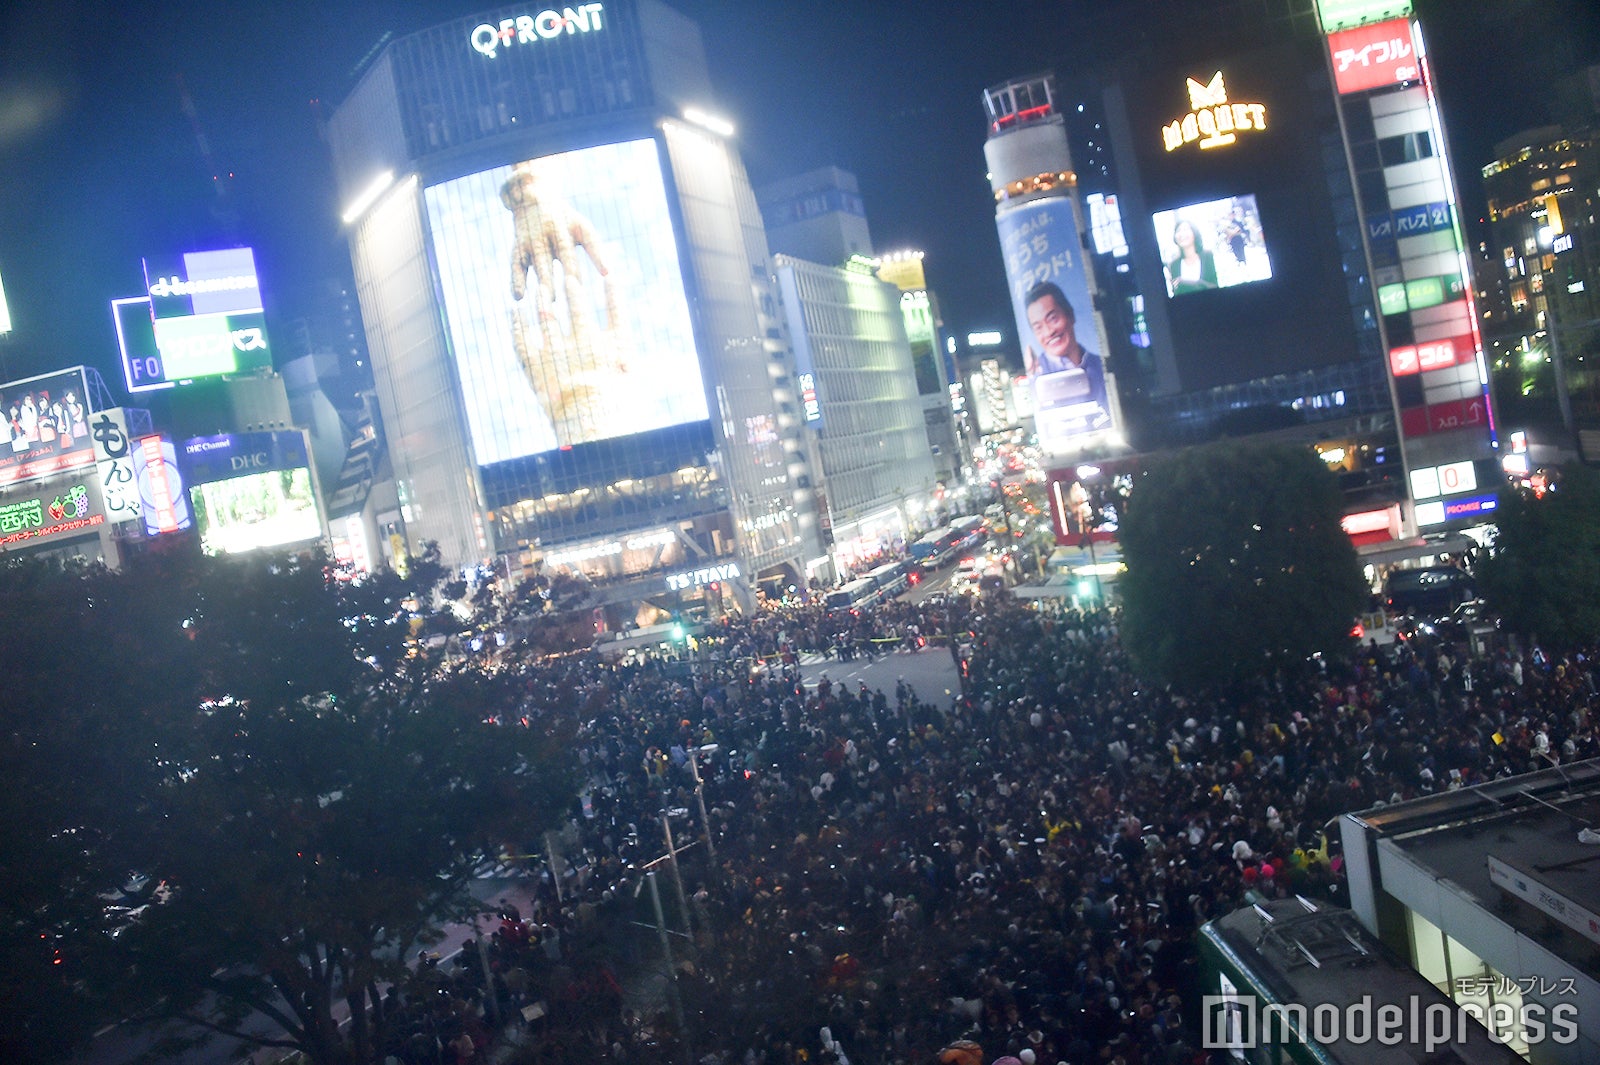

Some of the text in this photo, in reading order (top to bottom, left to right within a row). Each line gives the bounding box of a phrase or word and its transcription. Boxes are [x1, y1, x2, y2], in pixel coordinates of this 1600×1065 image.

[470, 3, 603, 58] QFRONT
[1333, 38, 1411, 72] アイフル
[1397, 345, 1454, 371] アコム
[202, 439, 231, 451] Channel
[92, 414, 141, 516] もんじゃ
[231, 452, 268, 470] DHC
[0, 507, 43, 533] 西村
